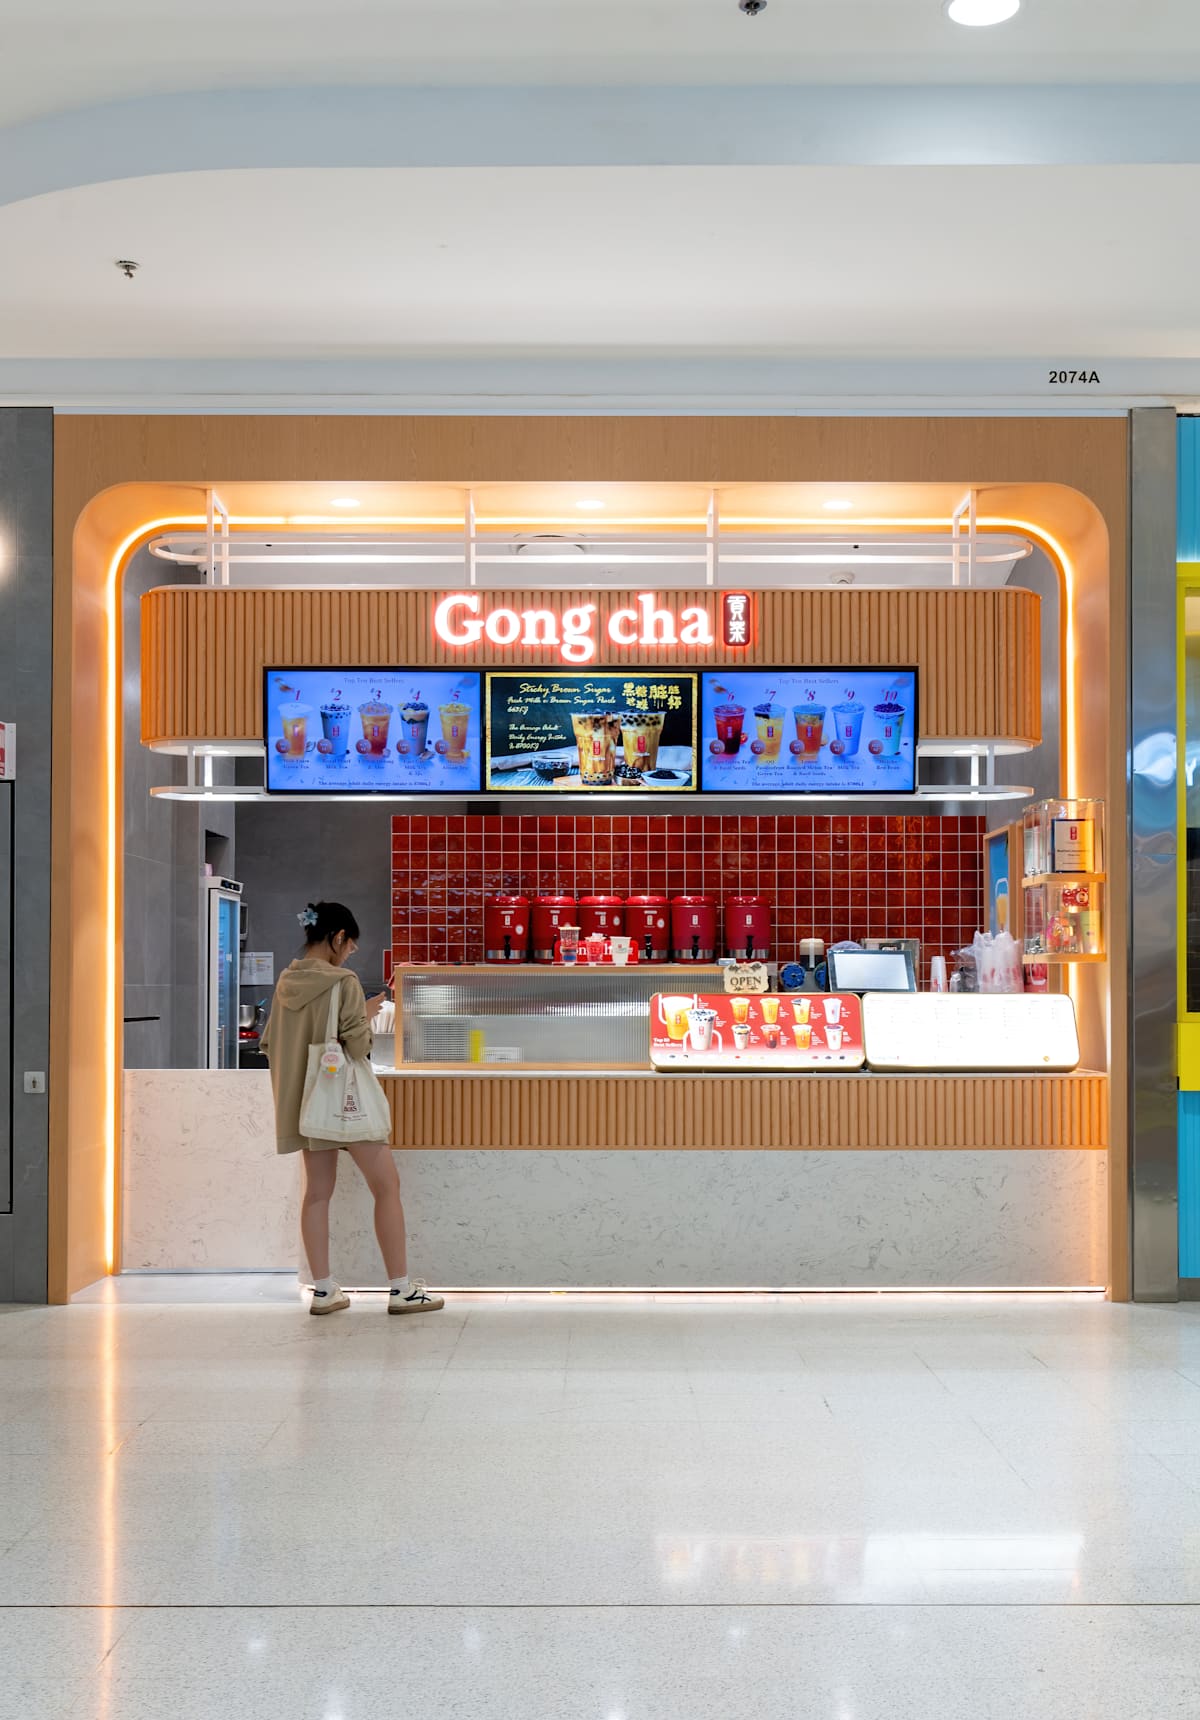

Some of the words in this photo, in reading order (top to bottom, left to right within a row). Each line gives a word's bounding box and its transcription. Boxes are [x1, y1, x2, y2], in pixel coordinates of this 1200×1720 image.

[1049, 371, 1100, 384] 2074A
[726, 595, 747, 643] 貢茶
[435, 594, 596, 662] Gong
[608, 593, 714, 645] cha
[519, 683, 550, 698] Sticky
[551, 683, 581, 694] Brown
[583, 682, 612, 697] Sugar
[730, 976, 762, 987] OPEN
